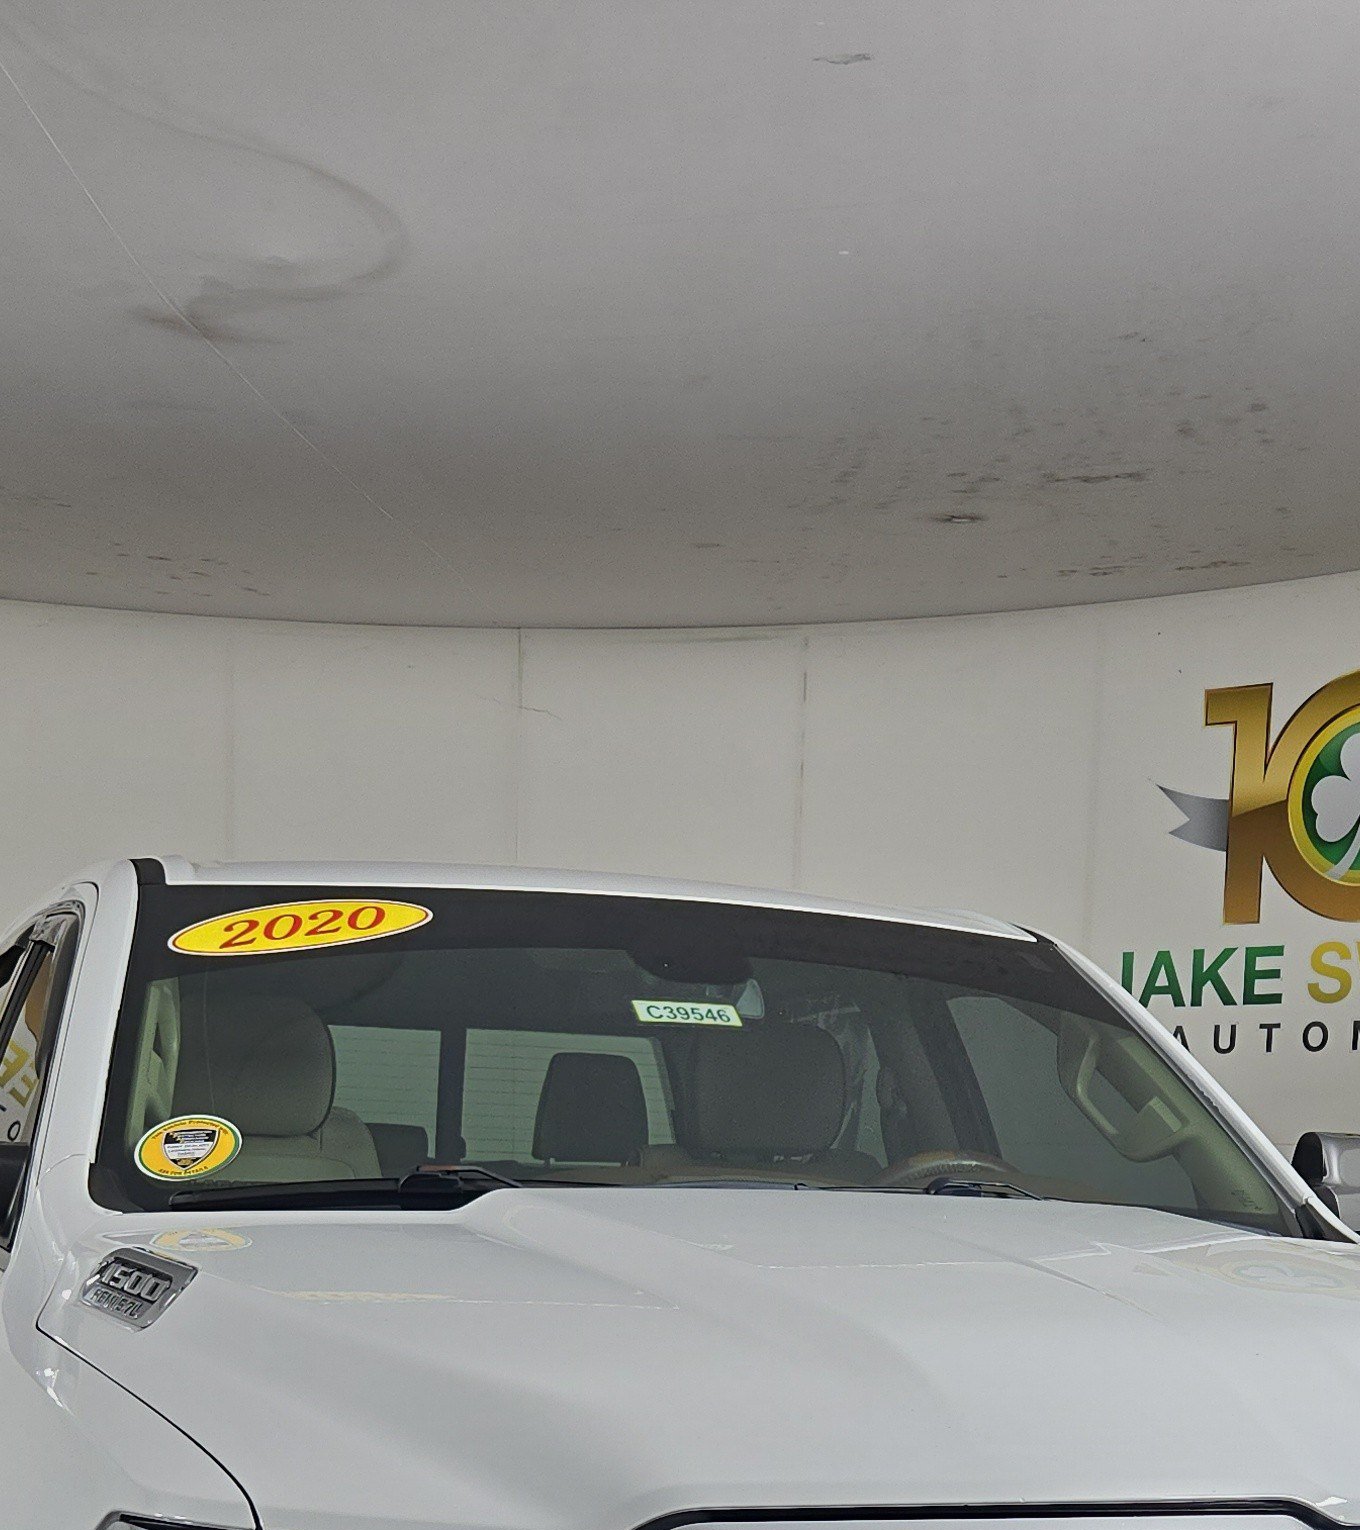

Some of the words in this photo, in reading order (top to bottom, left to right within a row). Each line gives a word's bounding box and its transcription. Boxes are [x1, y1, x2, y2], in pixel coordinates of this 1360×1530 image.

[219, 906, 386, 950] 2020
[646, 1005, 731, 1023] C39546
[101, 1261, 172, 1303] 1500
